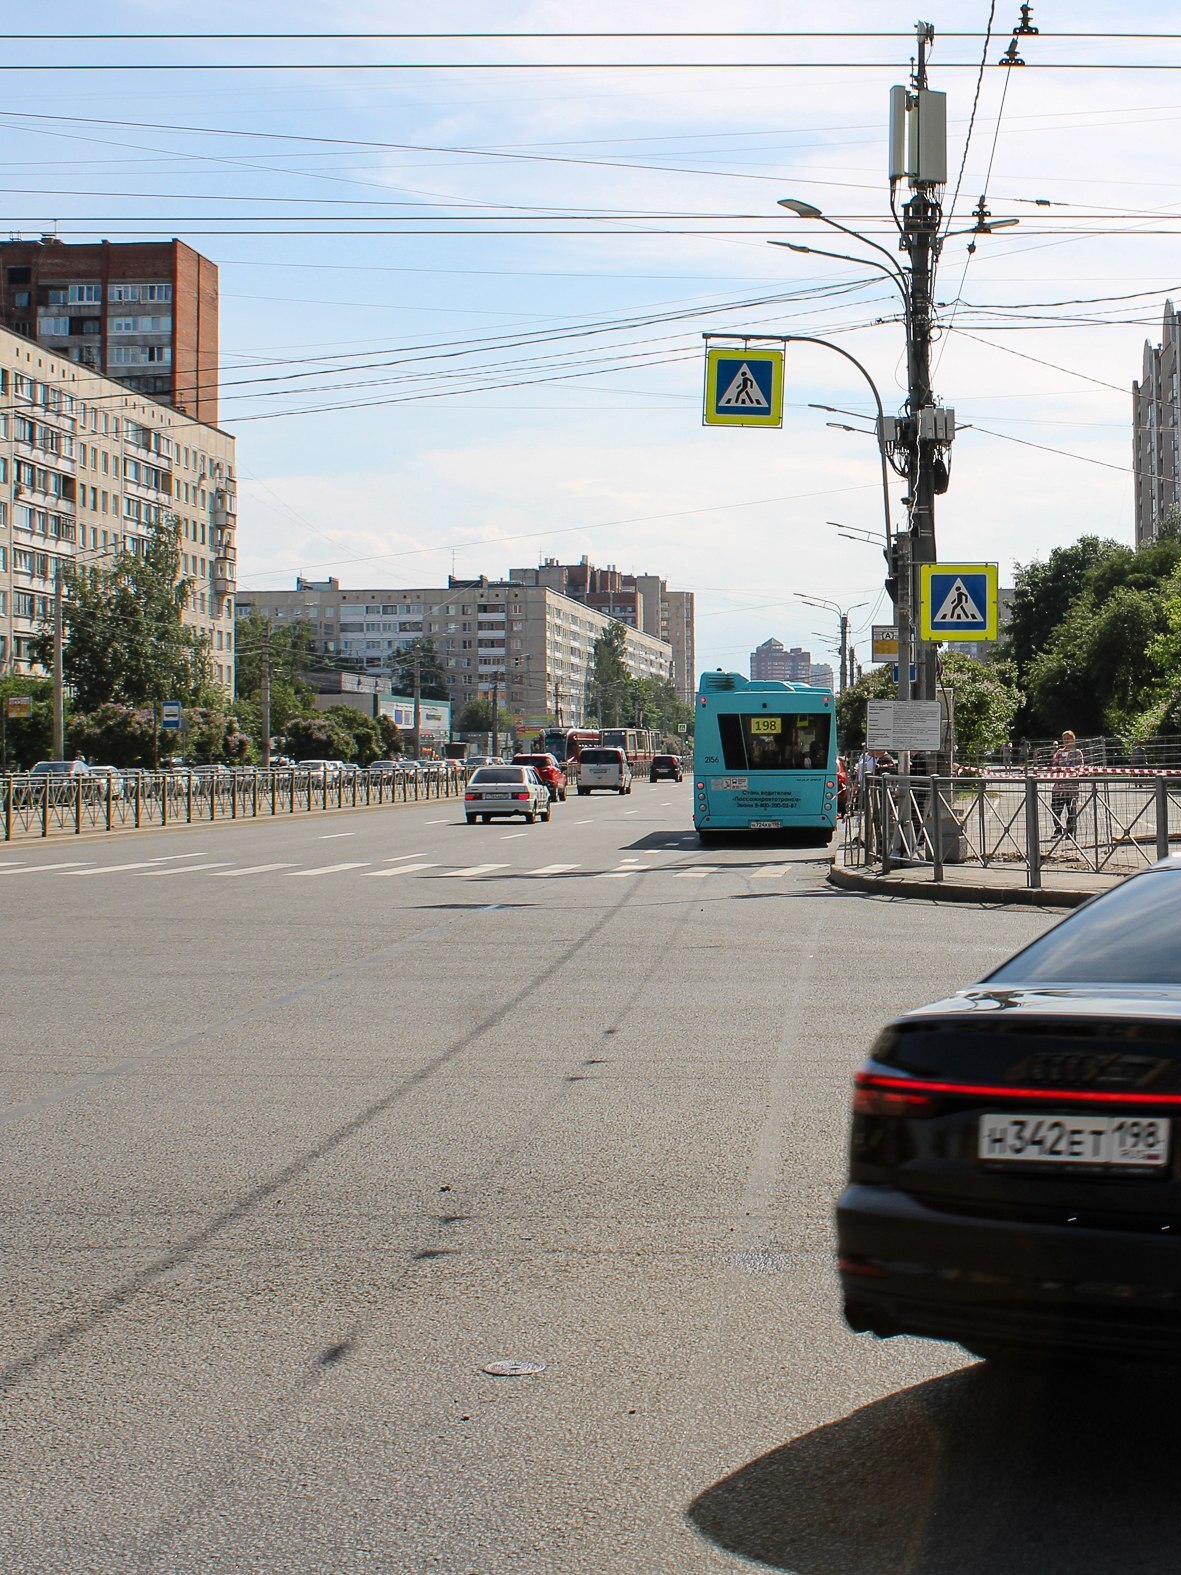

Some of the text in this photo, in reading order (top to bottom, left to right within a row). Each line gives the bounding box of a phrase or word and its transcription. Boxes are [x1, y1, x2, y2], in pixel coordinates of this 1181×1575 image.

[755, 720, 777, 731] 198
[704, 756, 719, 764] 2156
[1111, 1120, 1160, 1148] 198
